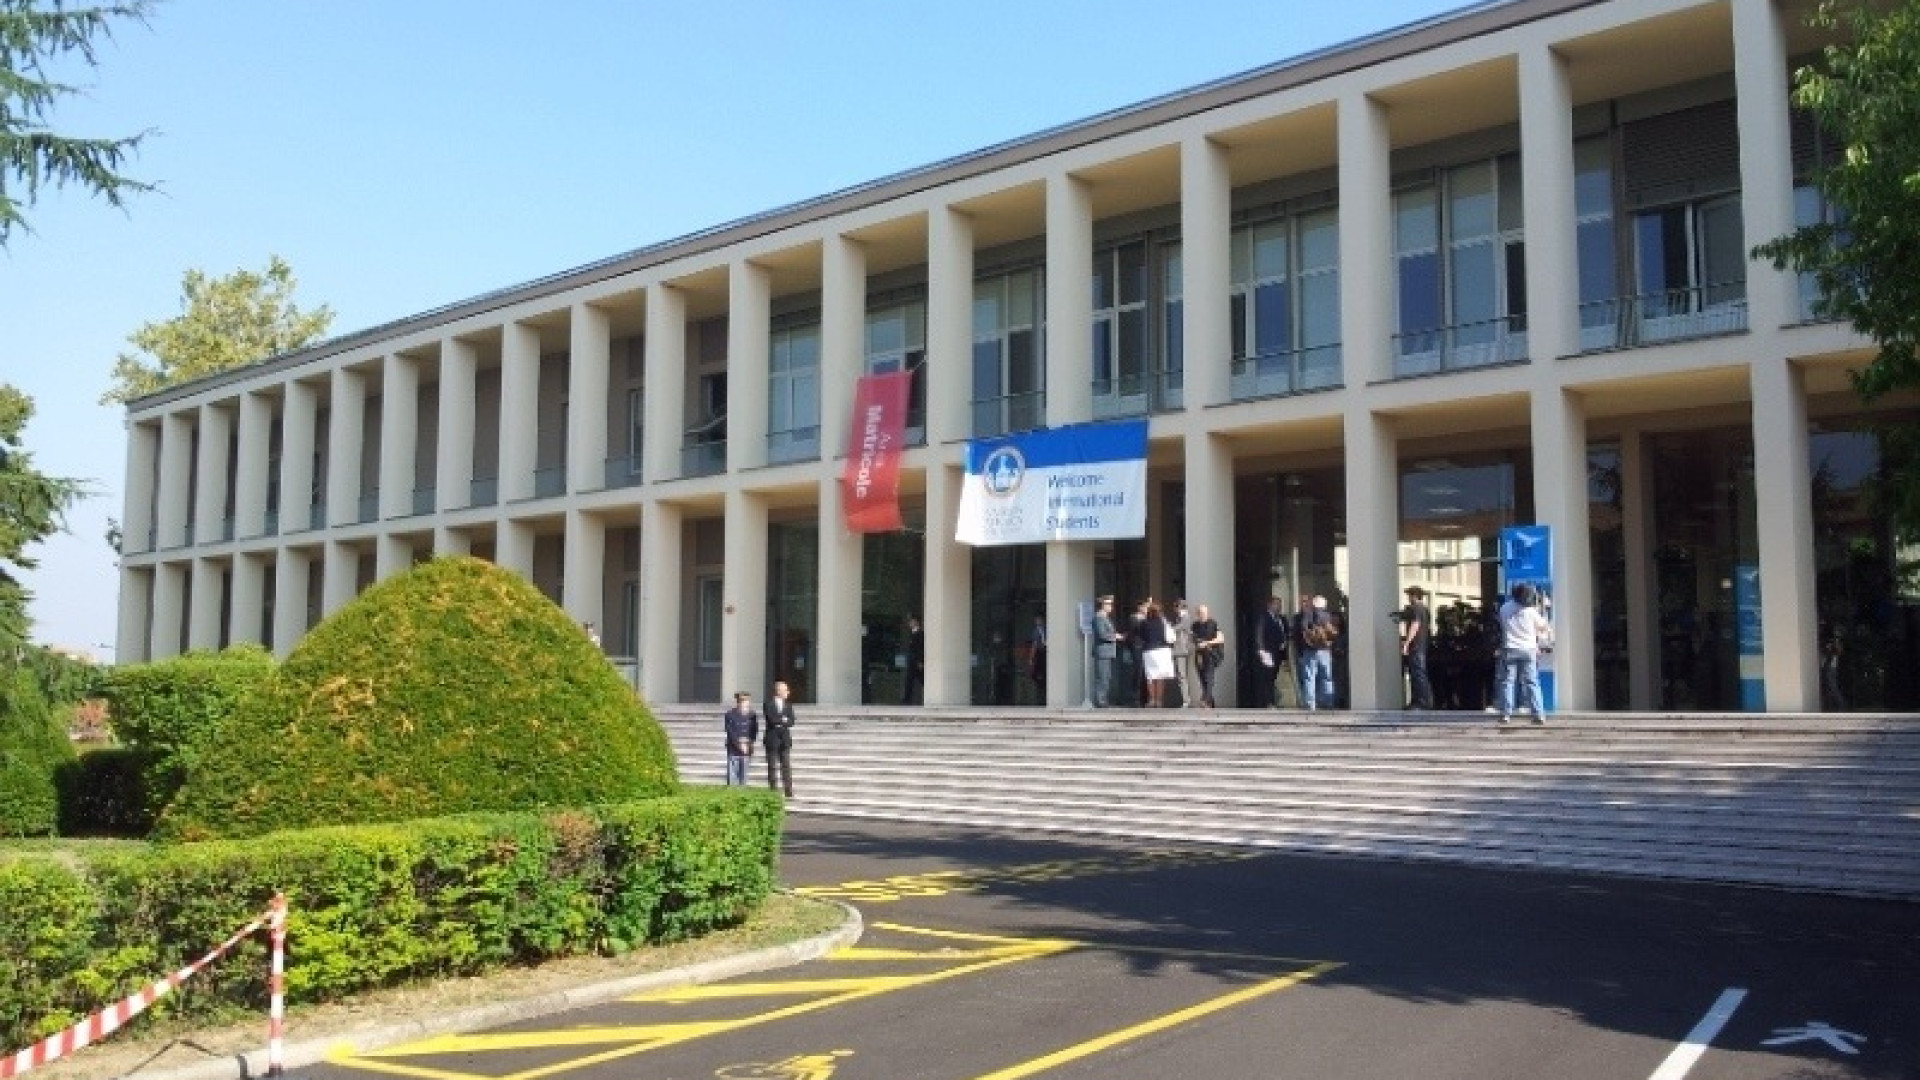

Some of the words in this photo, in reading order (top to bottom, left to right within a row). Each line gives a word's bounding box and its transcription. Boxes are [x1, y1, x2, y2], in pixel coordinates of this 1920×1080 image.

[856, 404, 884, 499] Matricole
[1047, 474, 1105, 488] Welcome
[1045, 515, 1100, 531] Students
